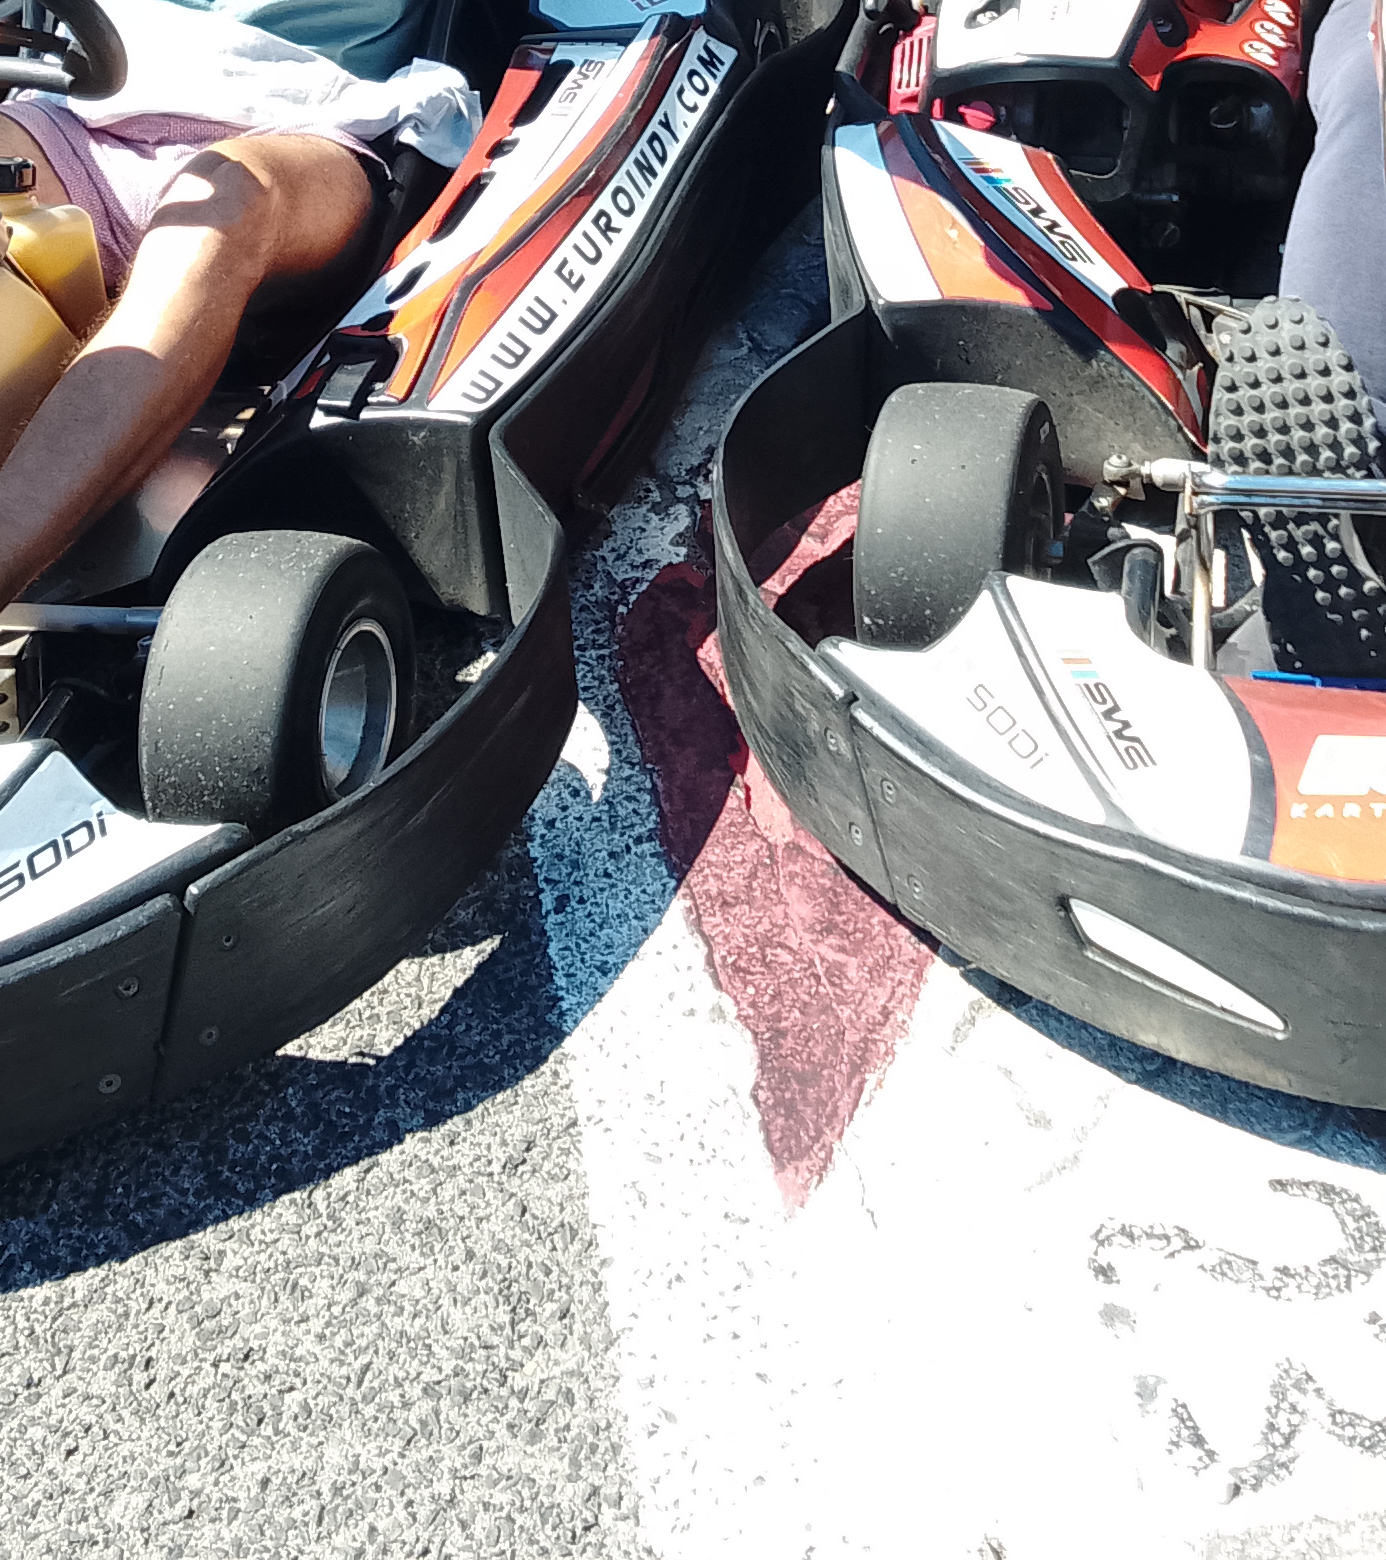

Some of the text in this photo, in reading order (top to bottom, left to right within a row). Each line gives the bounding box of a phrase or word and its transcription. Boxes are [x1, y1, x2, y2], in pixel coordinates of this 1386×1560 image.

[461, 39, 727, 404] WWW.EUROINDY.COM
[997, 185, 1096, 266] SWS
[1076, 681, 1158, 771] SWS
